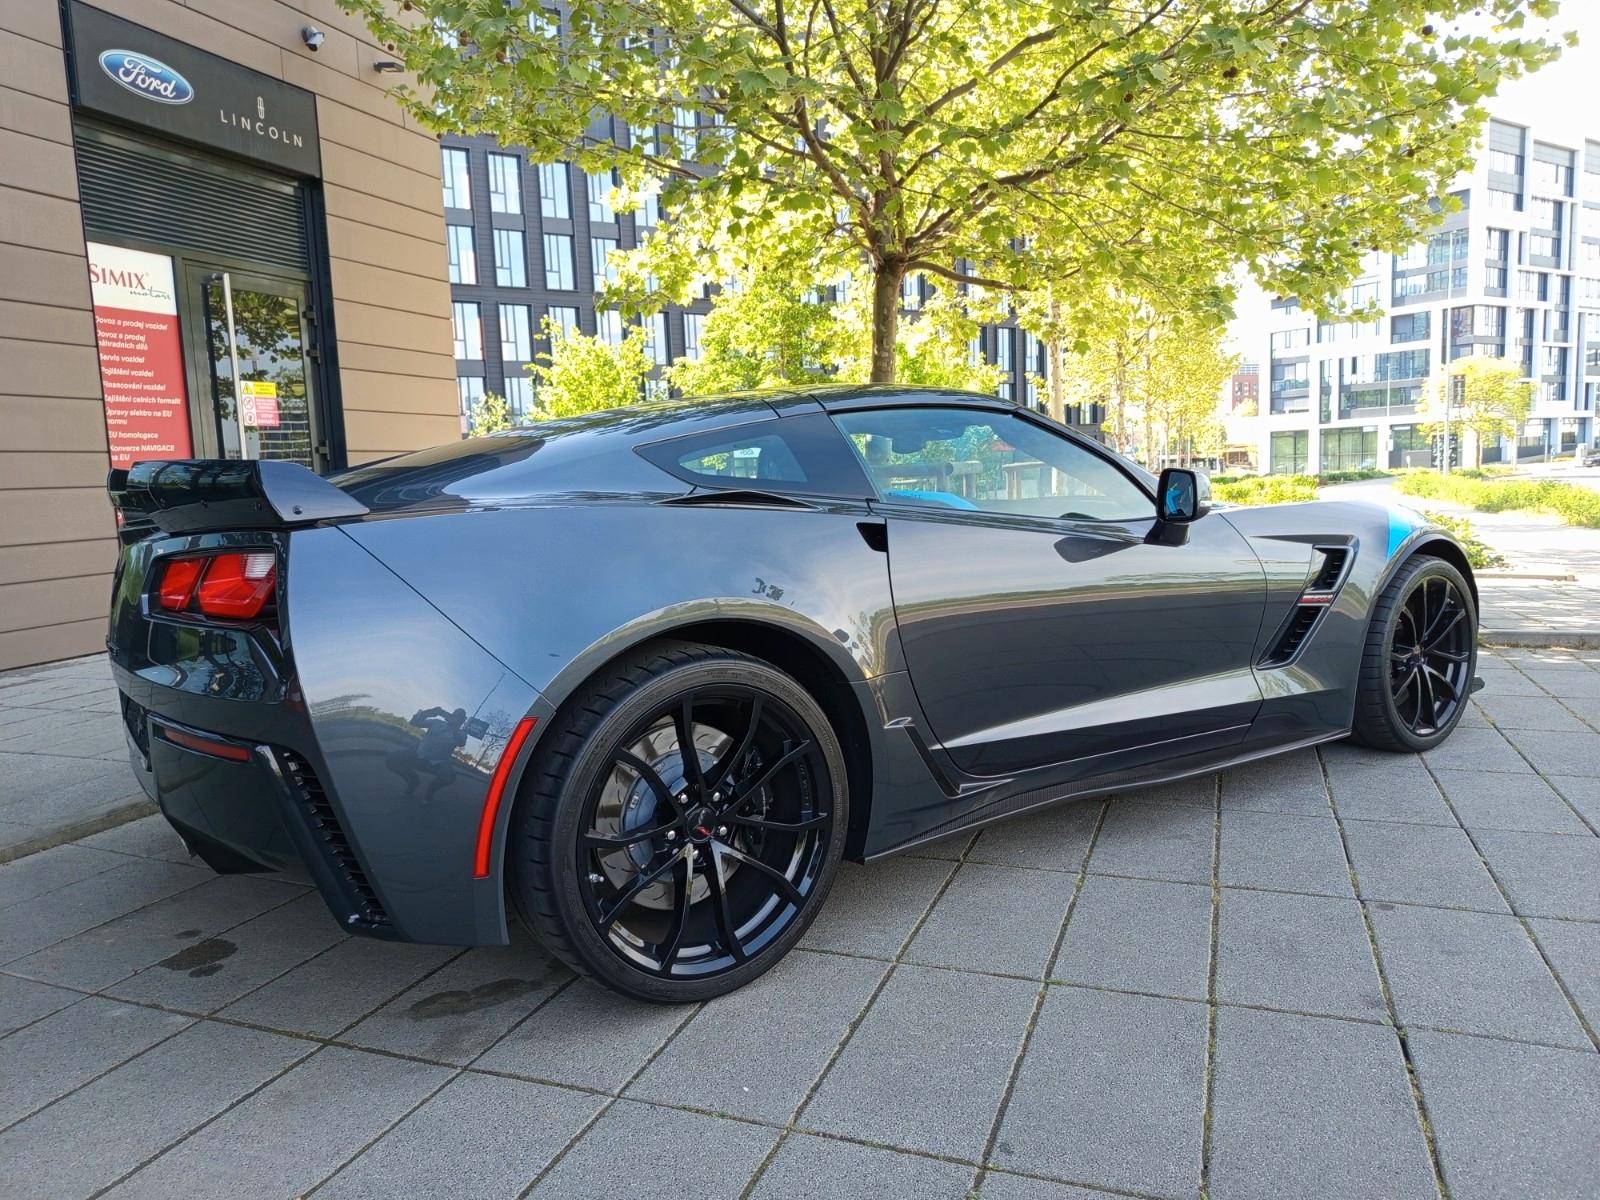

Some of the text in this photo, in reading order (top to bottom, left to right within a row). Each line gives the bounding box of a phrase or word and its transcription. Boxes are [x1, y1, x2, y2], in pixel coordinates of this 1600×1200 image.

[118, 57, 177, 98] Ford
[219, 109, 303, 148] LINCOLN
[129, 286, 171, 300] motors
[122, 320, 145, 330] prodej
[145, 322, 168, 331] vozidel
[124, 334, 146, 342] prodej
[121, 355, 145, 363] vozidel
[131, 370, 154, 378] vozidel
[143, 383, 166, 391] vozidel
[129, 408, 152, 417] elektro
[118, 431, 159, 440] homologace
[141, 444, 175, 452] NAVIGACE
[119, 453, 130, 461] EU
